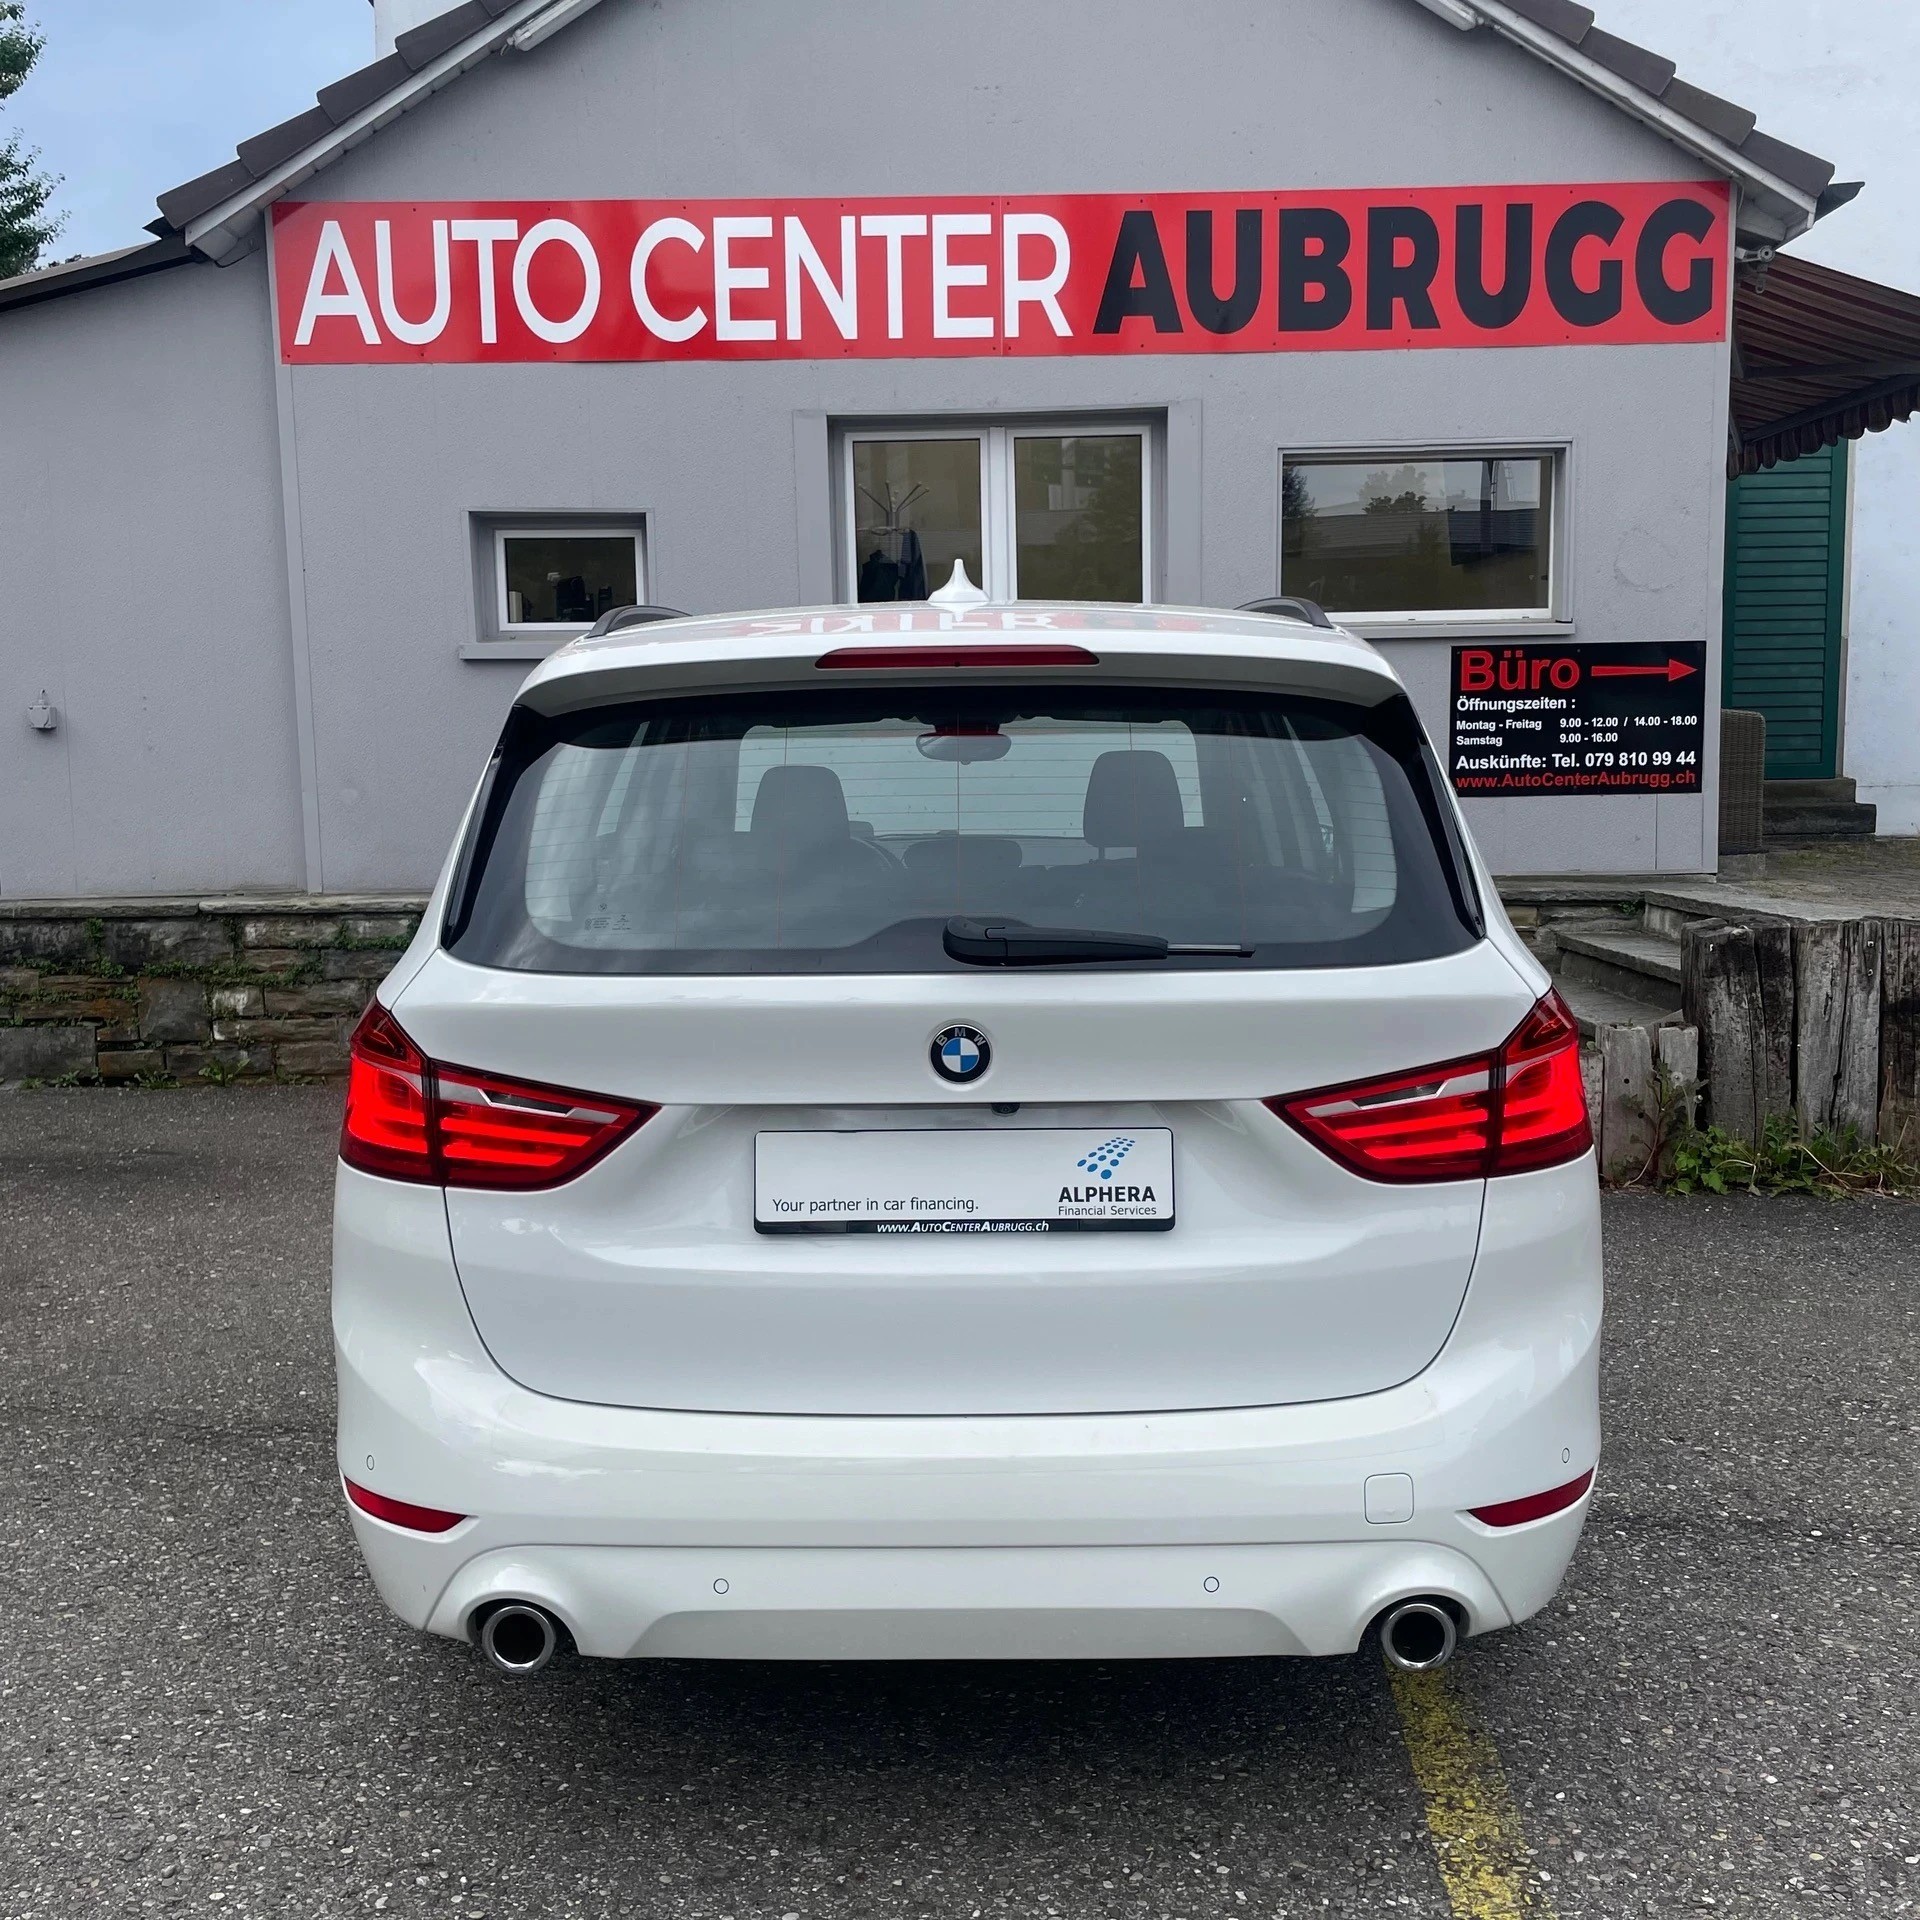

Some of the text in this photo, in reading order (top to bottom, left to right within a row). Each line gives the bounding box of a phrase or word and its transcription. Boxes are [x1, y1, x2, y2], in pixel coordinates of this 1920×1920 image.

[294, 198, 1716, 345] AUTO CENTER AUBRUGG
[1460, 649, 1580, 691] Büro
[1456, 696, 1567, 713] Öffnungszeiten
[1456, 720, 1496, 732] Montag
[1505, 719, 1542, 731] Freitag
[1560, 718, 1581, 728] 9.00
[1591, 717, 1619, 727] 12.00
[1633, 716, 1661, 726] 14.00
[1670, 715, 1697, 726] 18.00
[1456, 735, 1503, 747] Samstag
[1559, 733, 1581, 743] 9.00
[1591, 732, 1618, 742] 16.00
[1455, 750, 1696, 770] Auskünfte: Tel. 079 810 99 44
[1456, 769, 1696, 788] www.AutoCenterAubrugg.ch
[935, 1027, 987, 1047] BMW
[1058, 1186, 1156, 1203] ALPHERA
[772, 1196, 979, 1214] Your partner in car financing.
[1058, 1204, 1157, 1216] Financial Services
